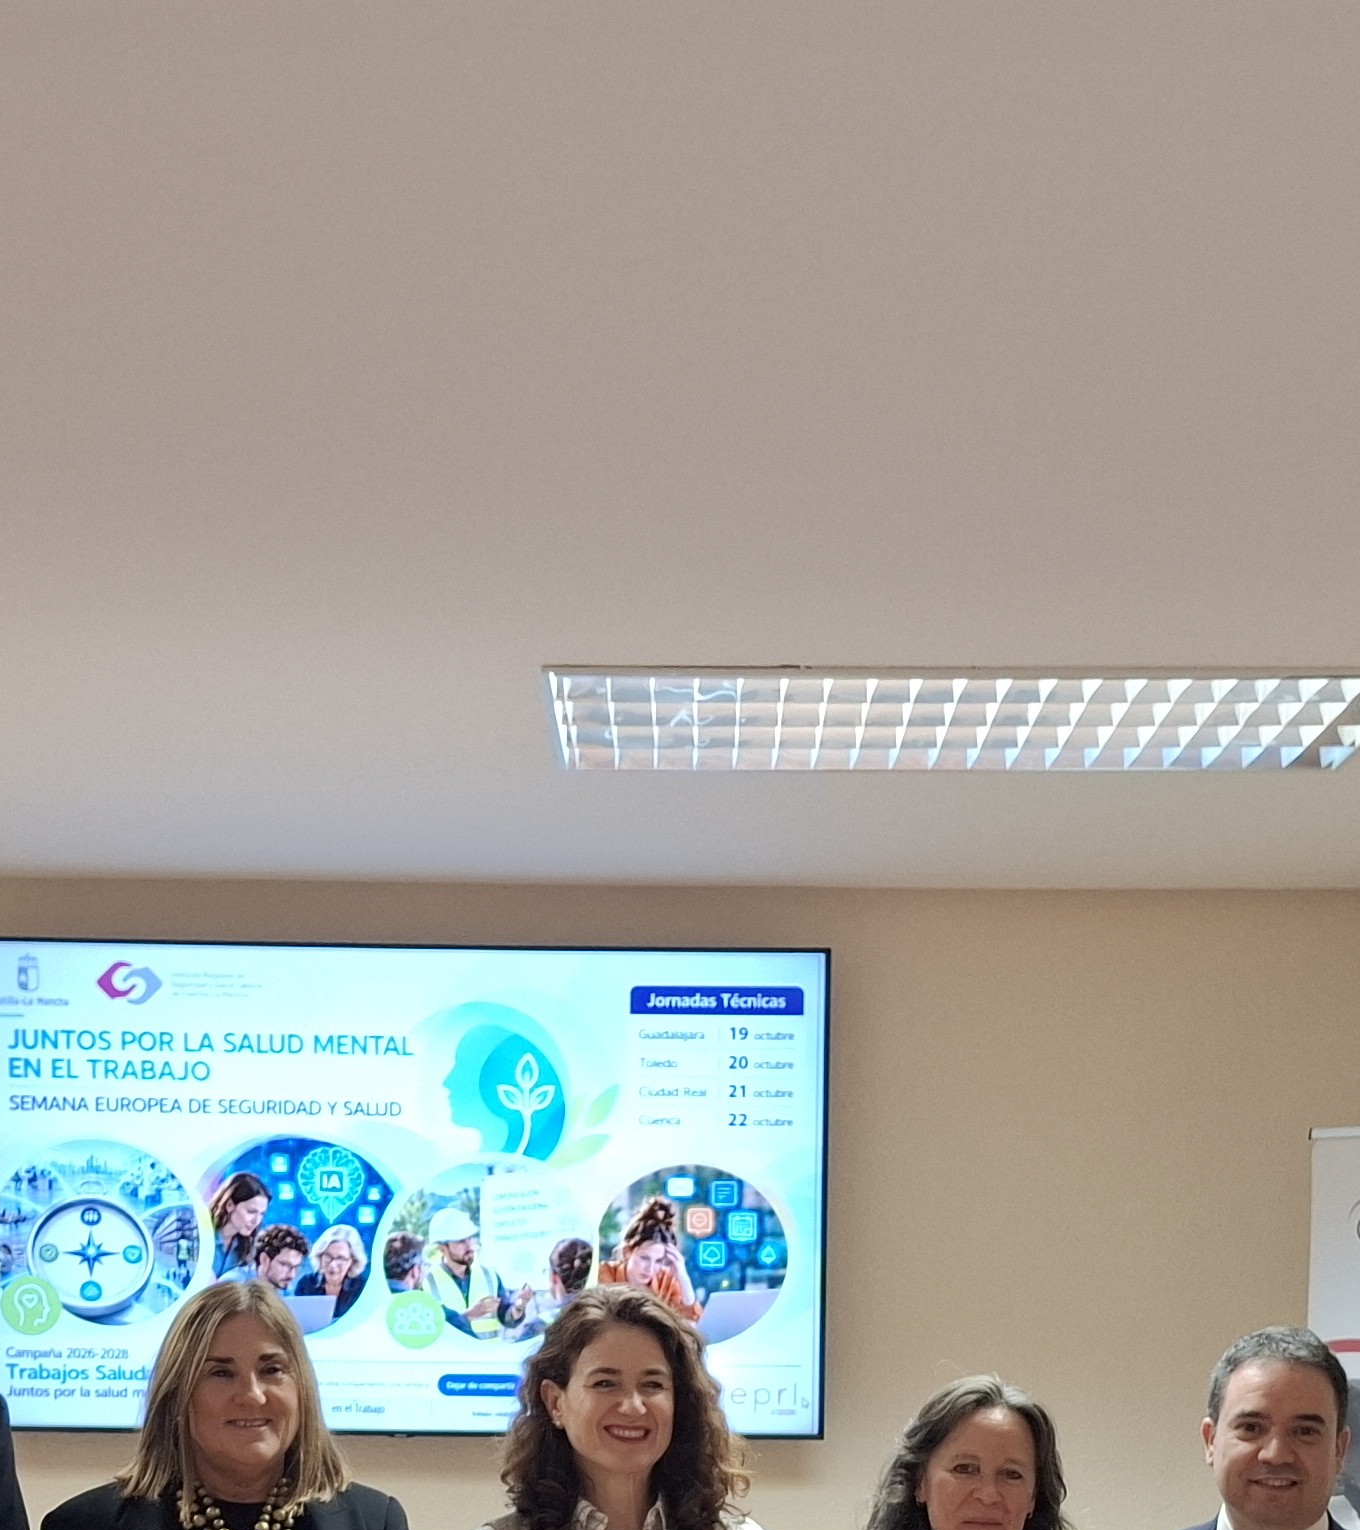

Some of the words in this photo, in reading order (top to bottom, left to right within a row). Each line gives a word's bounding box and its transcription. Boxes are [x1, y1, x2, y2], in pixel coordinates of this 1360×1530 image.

[646, 992, 717, 1009] Jornadas
[720, 992, 787, 1009] Técnicas
[729, 1026, 749, 1041] 19
[753, 1031, 795, 1041] octubre
[7, 1028, 111, 1051] JUNTOS
[121, 1031, 174, 1052] POR
[183, 1032, 214, 1052] LA
[223, 1033, 304, 1054] SALUD
[313, 1034, 414, 1056] MENTAL
[7, 1056, 41, 1078] EN
[51, 1058, 79, 1079] EL
[86, 1059, 211, 1081] TRABAJO
[728, 1055, 749, 1069] 20
[753, 1060, 794, 1070] octubre
[683, 1086, 707, 1097] Real
[728, 1084, 746, 1098] 21
[753, 1088, 794, 1098] octubre
[8, 1094, 89, 1112] SEMANA
[95, 1096, 182, 1113] EUROPEA
[188, 1098, 212, 1114] DE
[218, 1098, 322, 1115] SEGURIDAD
[327, 1101, 338, 1115] Y
[343, 1101, 402, 1117] SALUD
[728, 1113, 747, 1127] 22
[752, 1117, 793, 1127] octubre
[322, 1173, 341, 1189] IA
[5, 1345, 62, 1360] Campaña
[66, 1346, 129, 1360] 2026-2028
[5, 1362, 89, 1384] Trabajos
[6, 1384, 50, 1398] Juntos
[54, 1386, 76, 1400] por
[80, 1385, 90, 1398] la
[94, 1385, 128, 1398] salud
[730, 1382, 798, 1414] eprl
[331, 1404, 343, 1413] en
[344, 1403, 353, 1413] el
